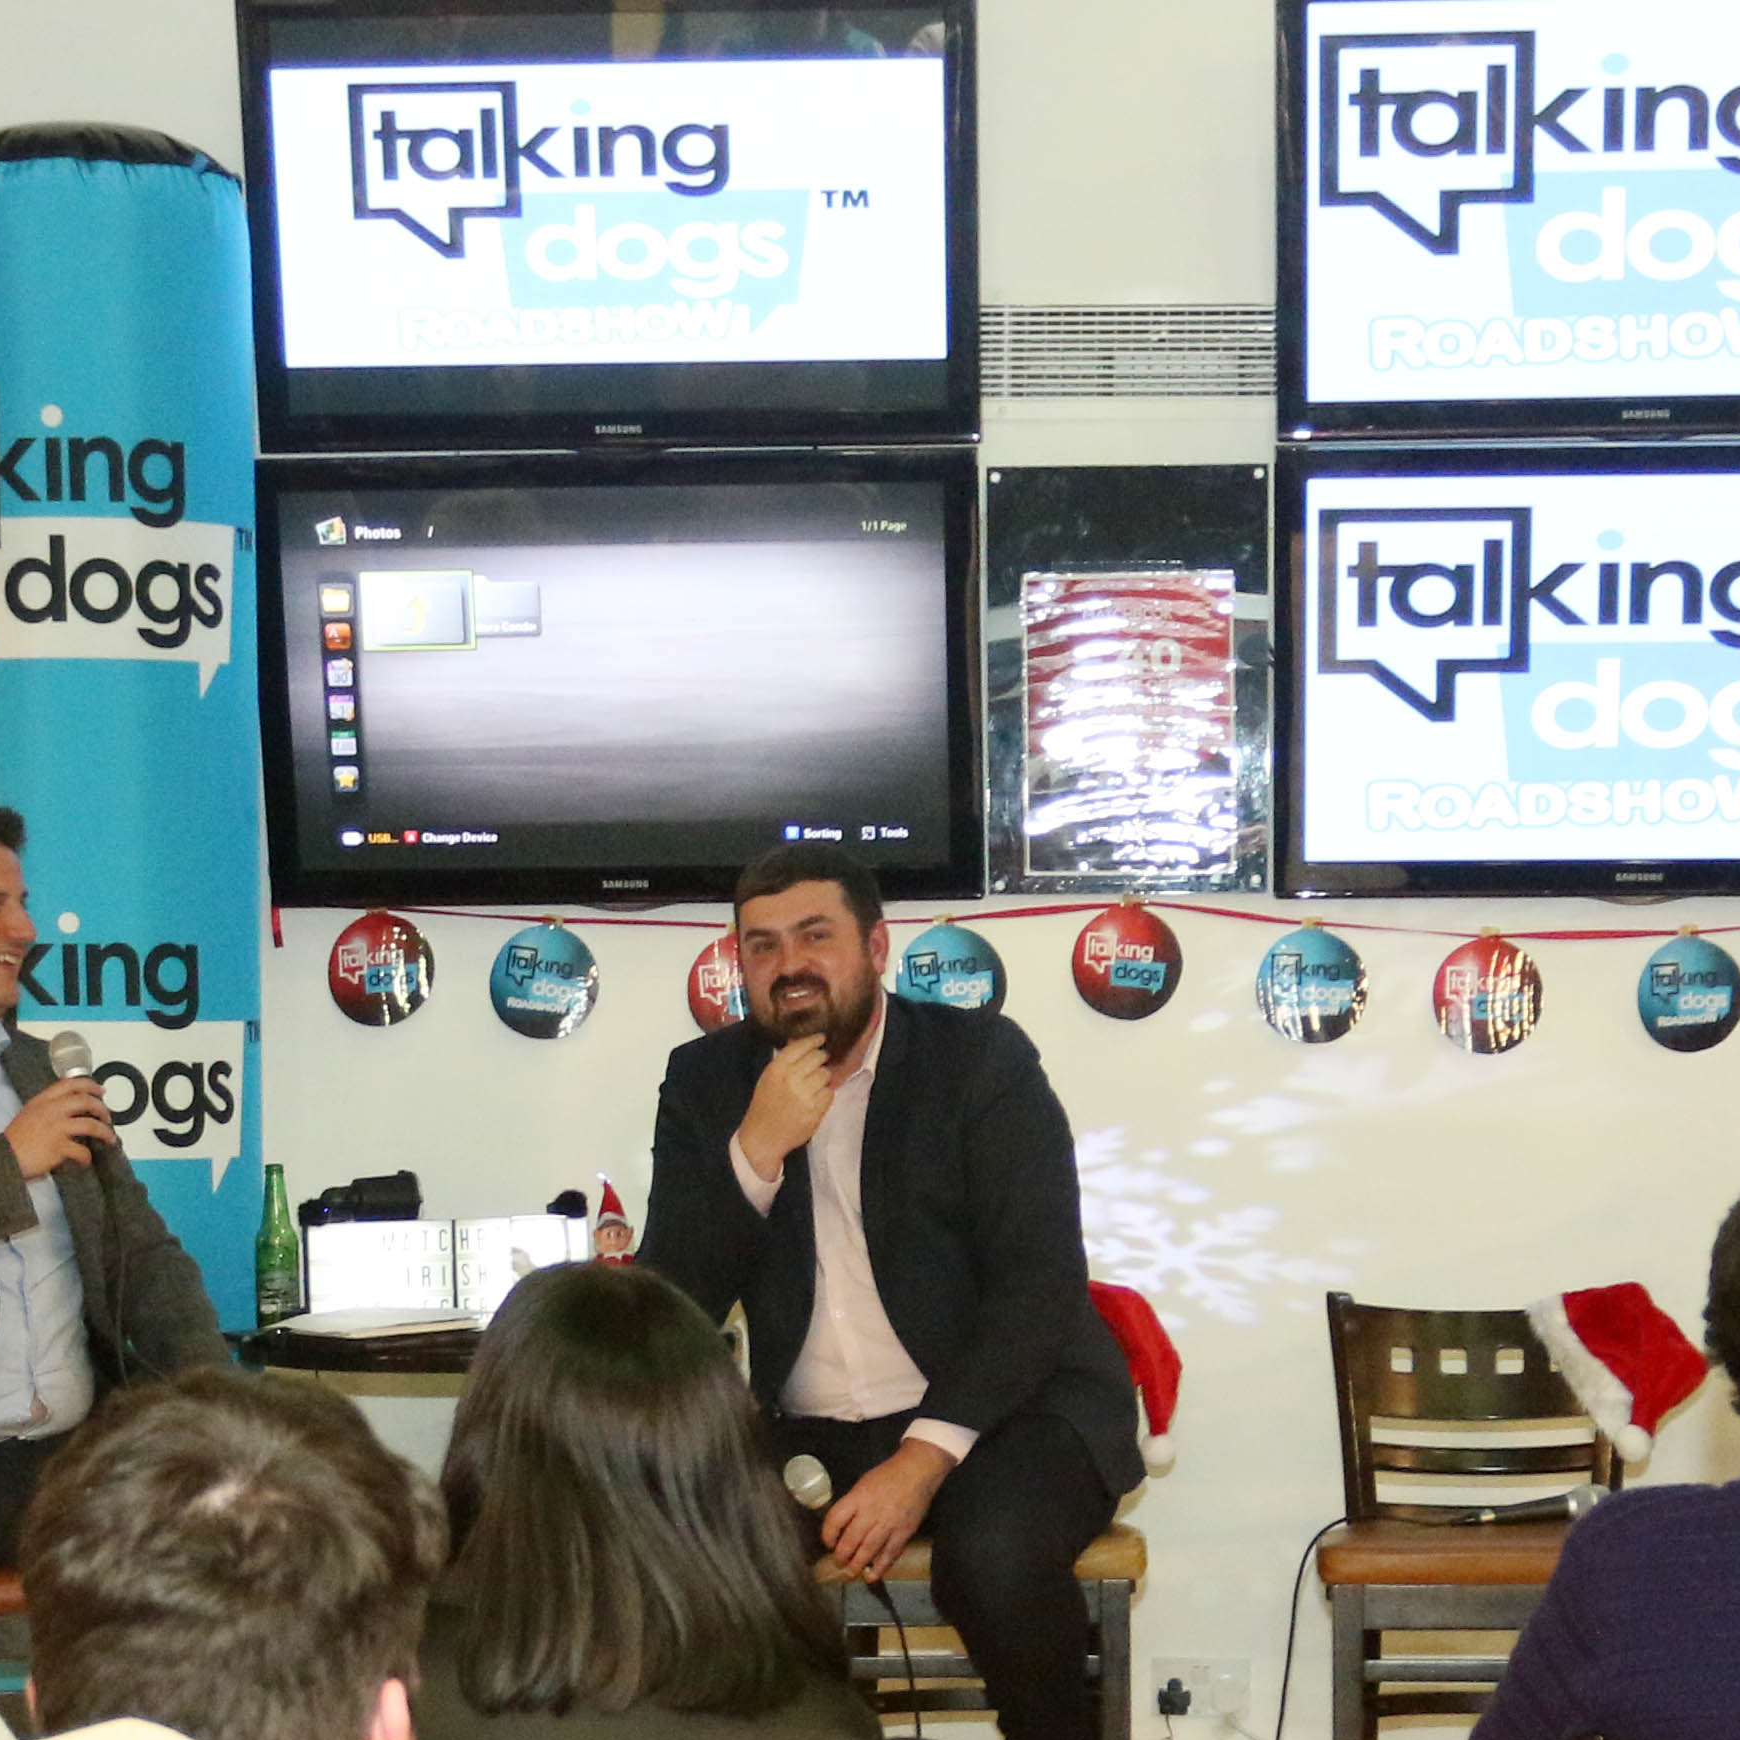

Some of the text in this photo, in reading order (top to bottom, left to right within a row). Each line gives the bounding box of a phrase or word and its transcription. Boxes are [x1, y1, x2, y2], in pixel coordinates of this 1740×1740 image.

[373, 99, 731, 197] talking
[821, 190, 871, 209] TM
[525, 204, 789, 298] dogs
[595, 424, 643, 435] SAMSUNG
[354, 525, 402, 540] Photos
[880, 519, 908, 533] Page
[5, 534, 223, 649] dogs
[1091, 937, 1155, 963] talking
[18, 911, 199, 1030] king
[511, 950, 574, 980] talking
[1115, 963, 1161, 986] dogs
[92, 1060, 235, 1148] ogs
[405, 1263, 490, 1289] IRISH
